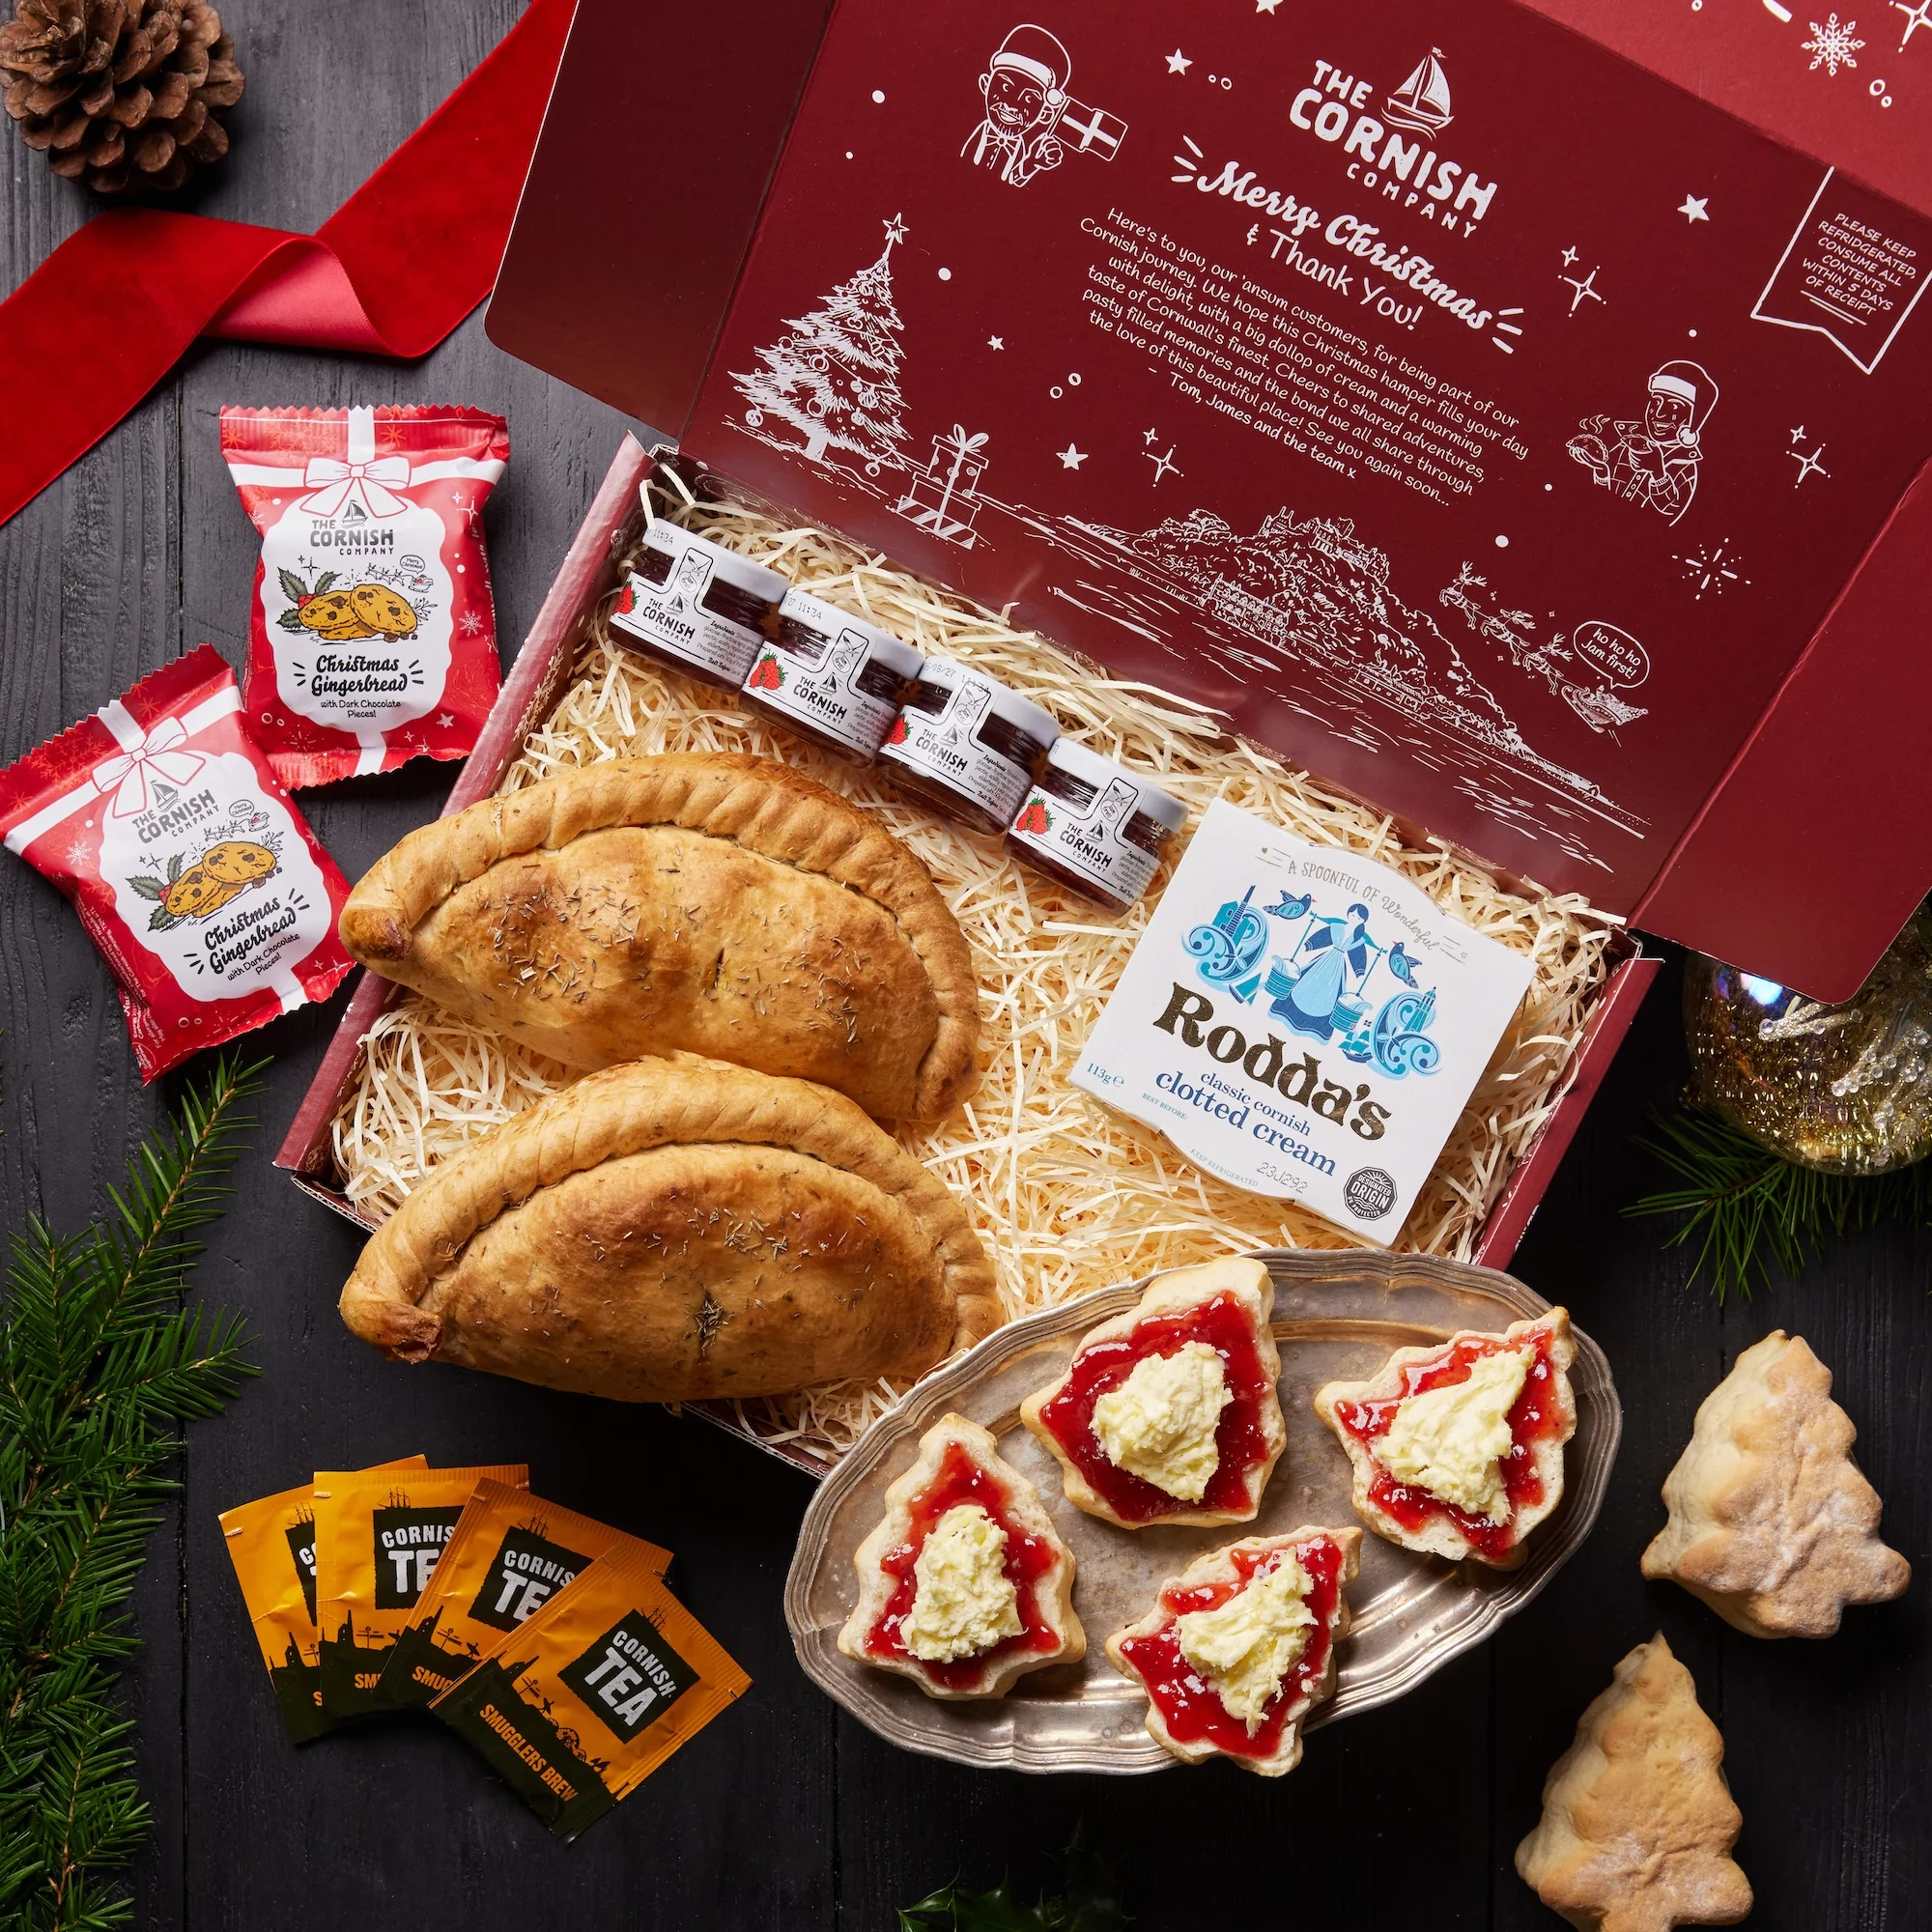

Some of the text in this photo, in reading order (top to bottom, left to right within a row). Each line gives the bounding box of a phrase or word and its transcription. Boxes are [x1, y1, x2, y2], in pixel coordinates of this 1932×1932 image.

[1314, 59, 1374, 110] THE
[1289, 88, 1498, 221] CORNISH
[1346, 162, 1477, 239] COMPANY
[1196, 160, 1492, 329] Merry Christmas
[1819, 221, 1916, 278] REFRIDGERATED,
[1835, 213, 1916, 258] PLEASE KEEP
[1246, 223, 1425, 331] & Thank You!
[1818, 238, 1901, 286] CONSUME ALL
[1822, 255, 1886, 292] CONTENTS
[1803, 258, 1893, 310] WITHIN 5 DAYS
[1806, 276, 1876, 315] OF RECEIPT
[1108, 208, 1519, 427] Here's to you, our 'ansum customers, for being part of our
[1081, 218, 1528, 460] Cornish journey. We hope this Christmas hamper fills your day
[1109, 257, 1482, 457] with delight, with a big dollop of cream and a warming
[1083, 290, 1472, 495] pasty filled memories and the bond we all share through
[1089, 265, 1484, 482] taste of Cornwall's finest. Cheers to shared adventures,
[1091, 310, 1448, 505] the love of this beautiful place! See you again soon...
[1171, 372, 1356, 478] Tom, James and the team x
[310, 528, 394, 547] CORNISH
[312, 519, 336, 529] THE
[653, 529, 673, 545] 11:34
[339, 547, 394, 555] COMPANY
[642, 606, 696, 639] CORNISH
[649, 598, 664, 610] THE
[798, 602, 822, 620] 11:34
[655, 625, 691, 644] COMPANY
[1592, 628, 1641, 667] ho ho ho
[316, 654, 400, 672] Christmas
[1581, 639, 1637, 679] Jam first!
[311, 673, 408, 696] Gingerbread
[793, 683, 848, 720] CORNISH
[799, 676, 816, 689] THE
[321, 699, 402, 708] with Dark Chocolate
[807, 704, 842, 724] COMPANY
[915, 736, 968, 772] CORNISH
[923, 728, 937, 741] THE
[927, 755, 962, 777] COMPANY
[132, 810, 156, 829] THE
[138, 789, 215, 843] CORNISH
[171, 805, 219, 838] COMPANY
[1066, 823, 1083, 837] THE
[1059, 831, 1113, 868] CORNISH
[1072, 851, 1106, 873] COMPANY
[205, 897, 281, 951] Christmas
[1288, 860, 1439, 951] A SPOONFUL OF Wonderful
[210, 906, 297, 975] Gingerbread
[227, 933, 299, 980] with Dark Chocolate
[255, 952, 281, 975] Pieces!
[1152, 981, 1392, 1141] Rodda's
[1142, 1093, 1188, 1120] BEST BEFORE:
[1201, 1072, 1311, 1136] classic cornish
[1155, 1071, 1337, 1177] clotted cream
[1190, 1148, 1259, 1187] KEEP REFRIGERATED
[1358, 1175, 1392, 1197] DESIGNATED
[1350, 1180, 1389, 1209] ORIGIN
[381, 1524, 455, 1548] CORNIS
[387, 1548, 440, 1594] TE
[503, 1549, 577, 1587] CORNIS
[494, 1569, 552, 1623] TE
[612, 1630, 676, 1697] CORNISH
[583, 1646, 658, 1727] TEA
[479, 1703, 580, 1802] SMUGGLERS BREW
